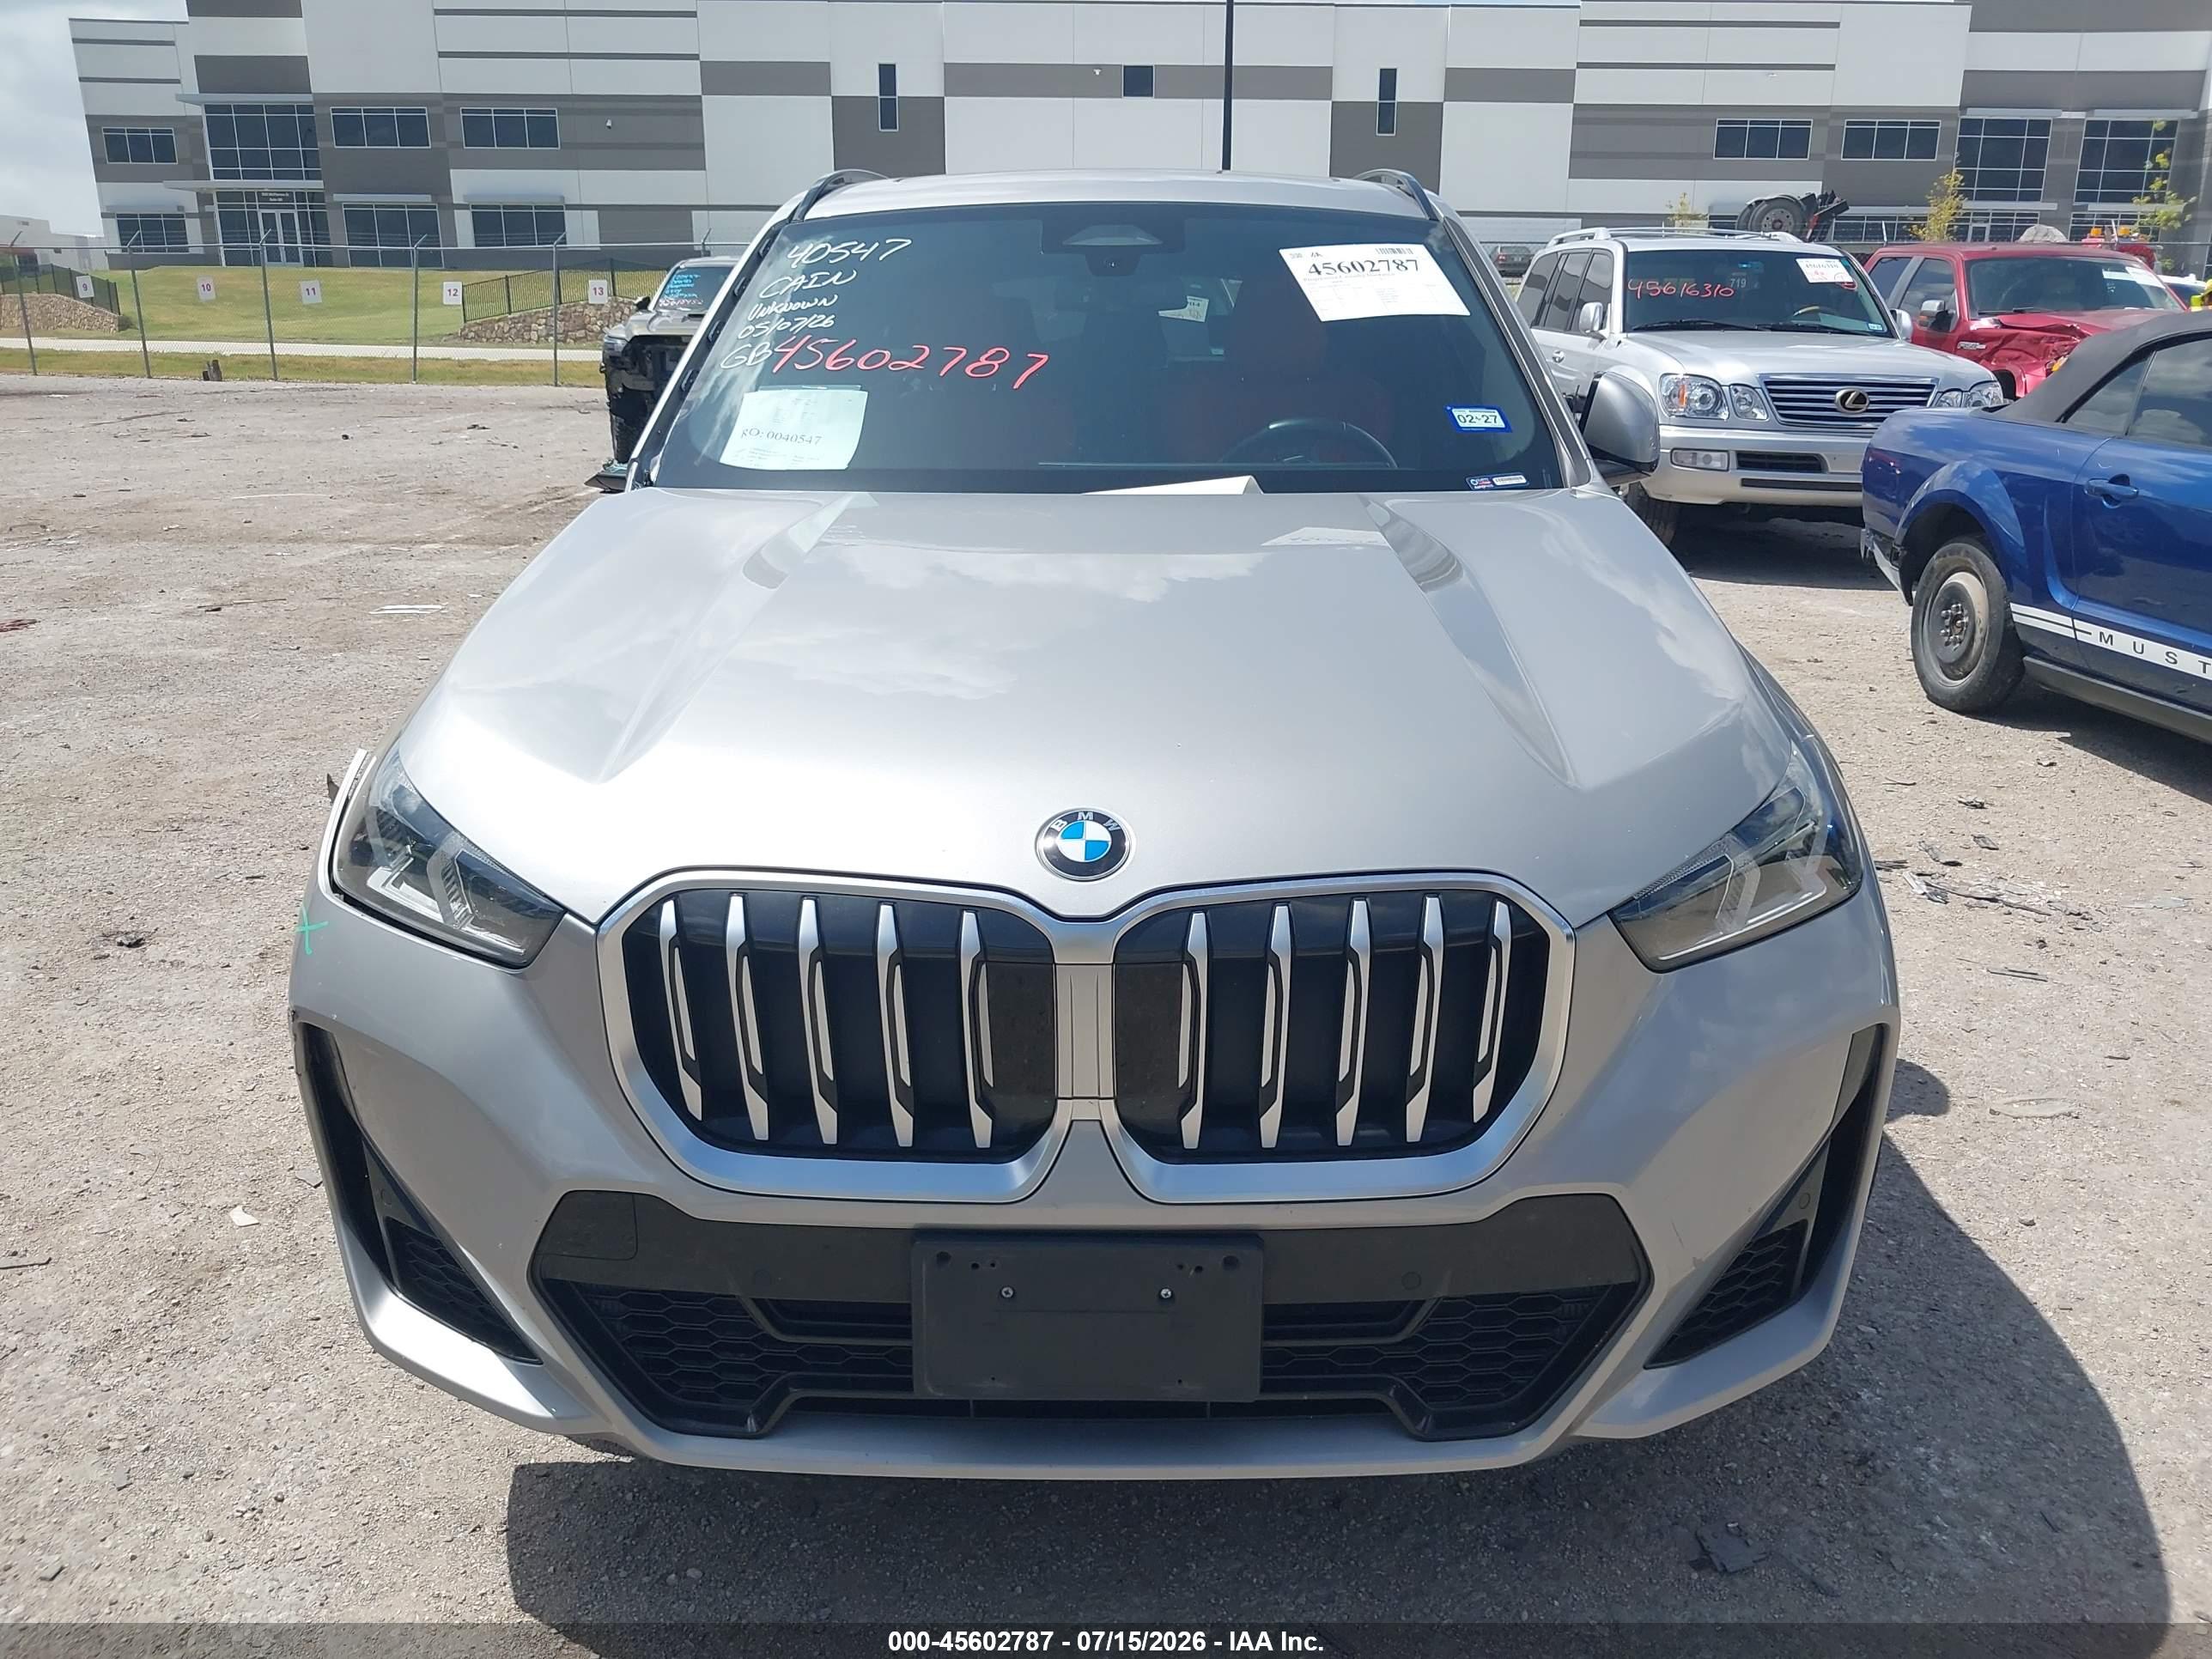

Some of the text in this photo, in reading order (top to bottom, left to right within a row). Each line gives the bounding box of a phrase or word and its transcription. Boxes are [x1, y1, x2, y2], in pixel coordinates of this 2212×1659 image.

[787, 238, 913, 269] 40547
[1307, 258, 1419, 276] 45602787
[82, 283, 88, 292] 9
[201, 283, 212, 293] 10
[305, 287, 317, 296] 11
[447, 289, 459, 297] 12
[592, 288, 605, 296] 13
[1627, 277, 1735, 299] 45616310
[737, 313, 836, 340] 05/07/26
[773, 334, 1050, 391] 45602787
[766, 430, 823, 446] 0040547
[2099, 631, 2212, 674] MUST
[1050, 811, 1121, 832] BMW
